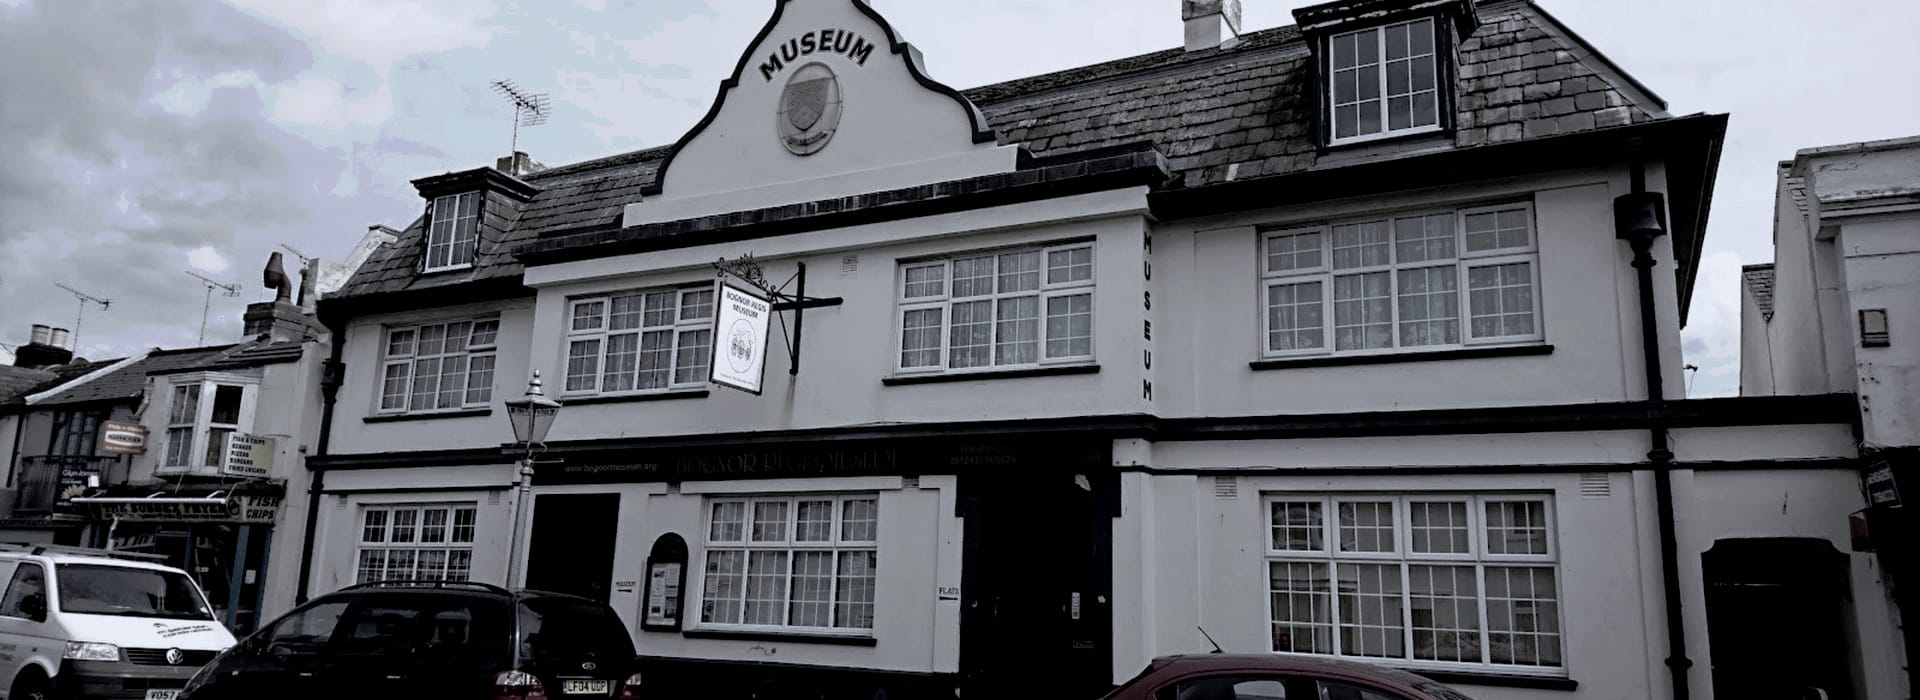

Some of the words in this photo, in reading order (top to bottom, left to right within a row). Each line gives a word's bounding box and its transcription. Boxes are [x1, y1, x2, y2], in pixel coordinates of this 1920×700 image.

[759, 28, 876, 82] MUSEUM
[726, 291, 750, 306] BOGNOR
[751, 301, 767, 313] REGIS
[733, 304, 759, 318] MUSEUM
[1142, 231, 1152, 402] MUSEUM
[673, 453, 757, 475] BOGNOR
[823, 448, 896, 471] MUSEUM
[248, 496, 279, 507] FISH
[246, 508, 275, 519] CHIPS
[939, 586, 959, 595] FLATS
